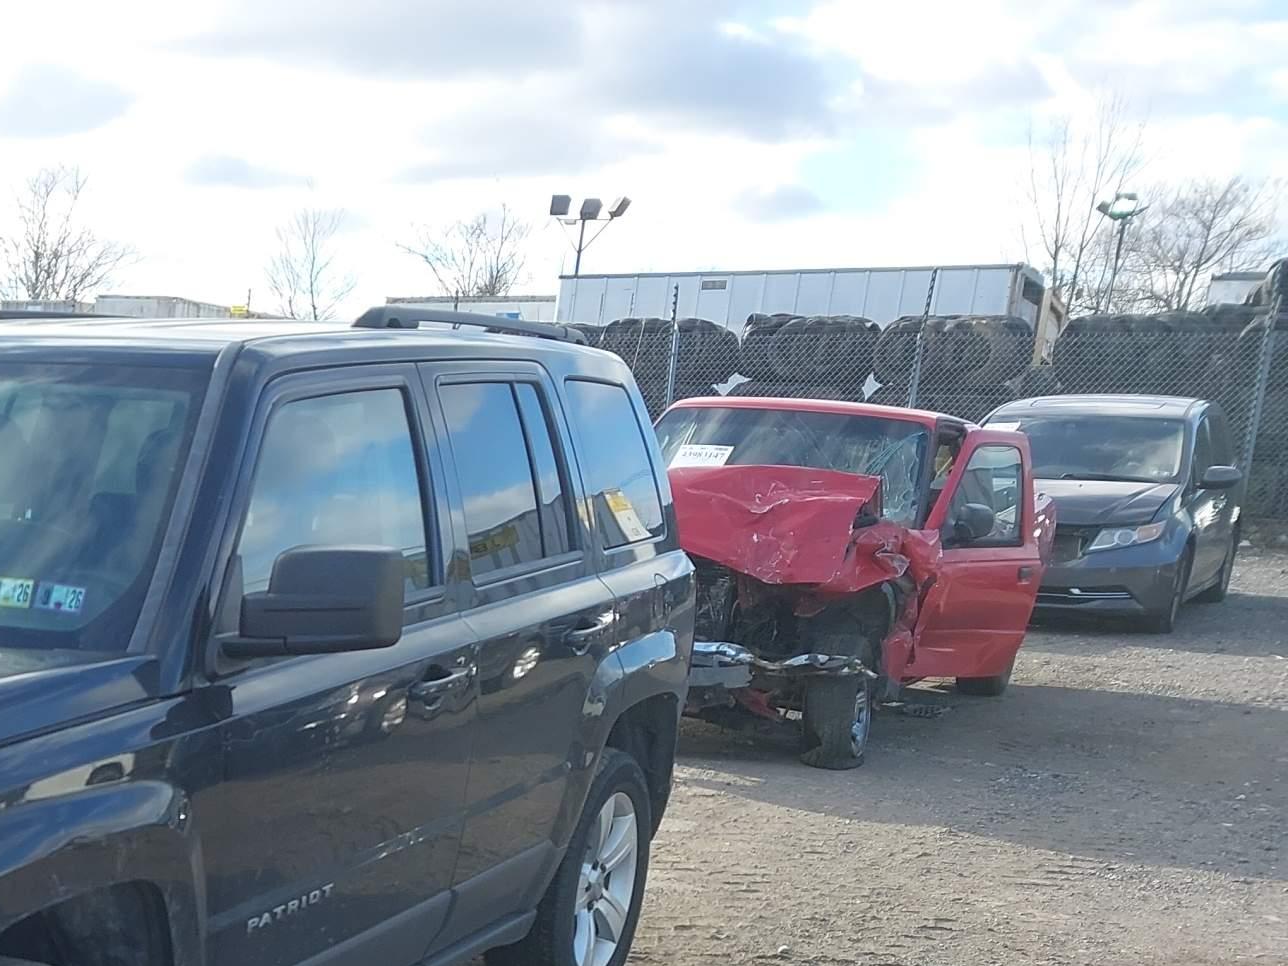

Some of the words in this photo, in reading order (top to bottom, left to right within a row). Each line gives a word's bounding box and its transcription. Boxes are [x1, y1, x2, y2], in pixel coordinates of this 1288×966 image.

[16, 584, 30, 602] 26
[68, 590, 83, 608] 26
[246, 882, 335, 934] PATRIOT
